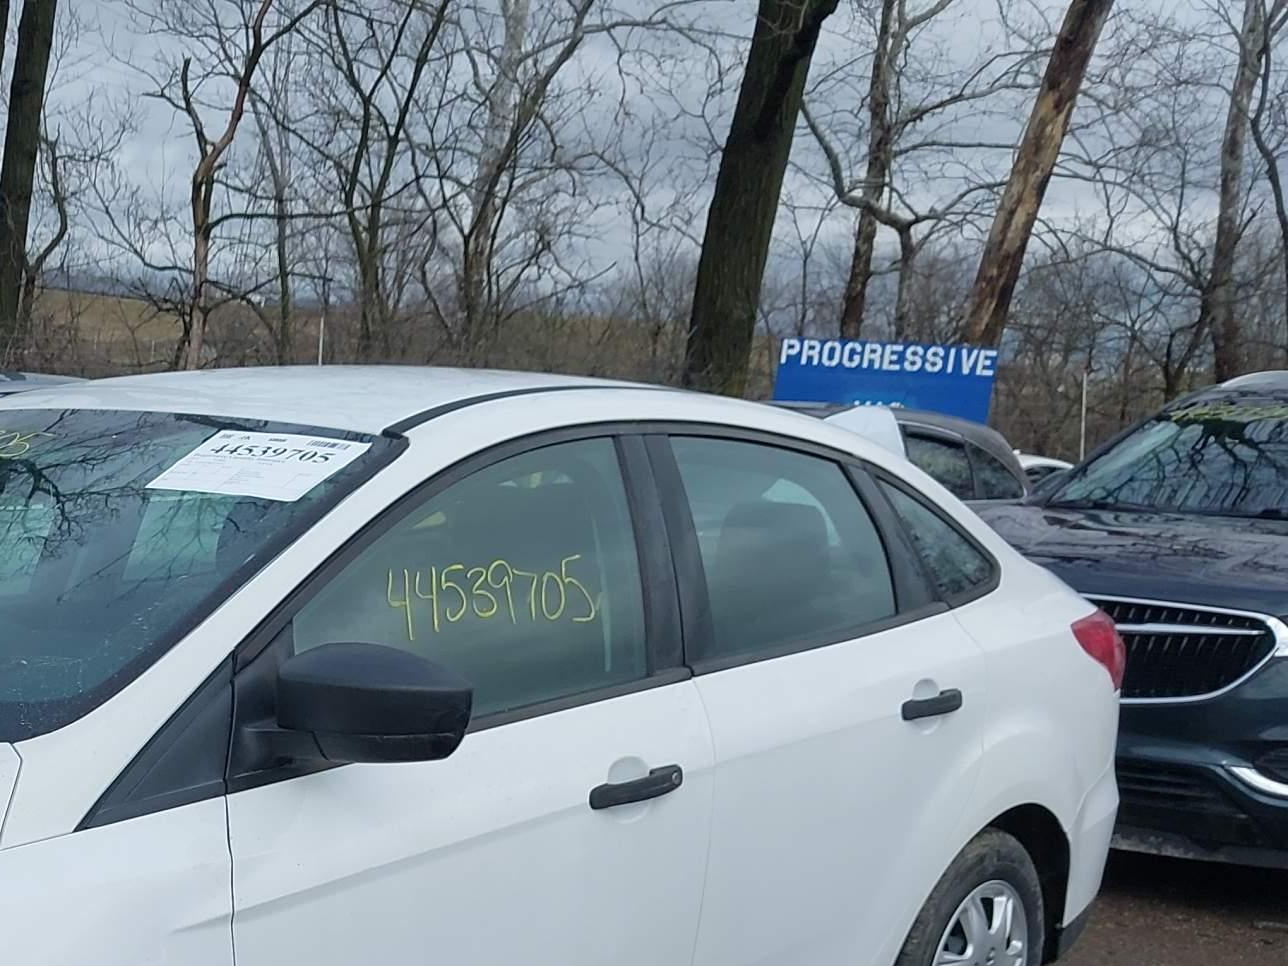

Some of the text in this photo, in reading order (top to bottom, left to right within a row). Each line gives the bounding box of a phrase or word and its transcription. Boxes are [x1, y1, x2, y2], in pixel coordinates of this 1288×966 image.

[780, 338, 998, 376] PROGRESSIVE
[210, 443, 336, 464] 44539705
[387, 554, 596, 641] 44539705
